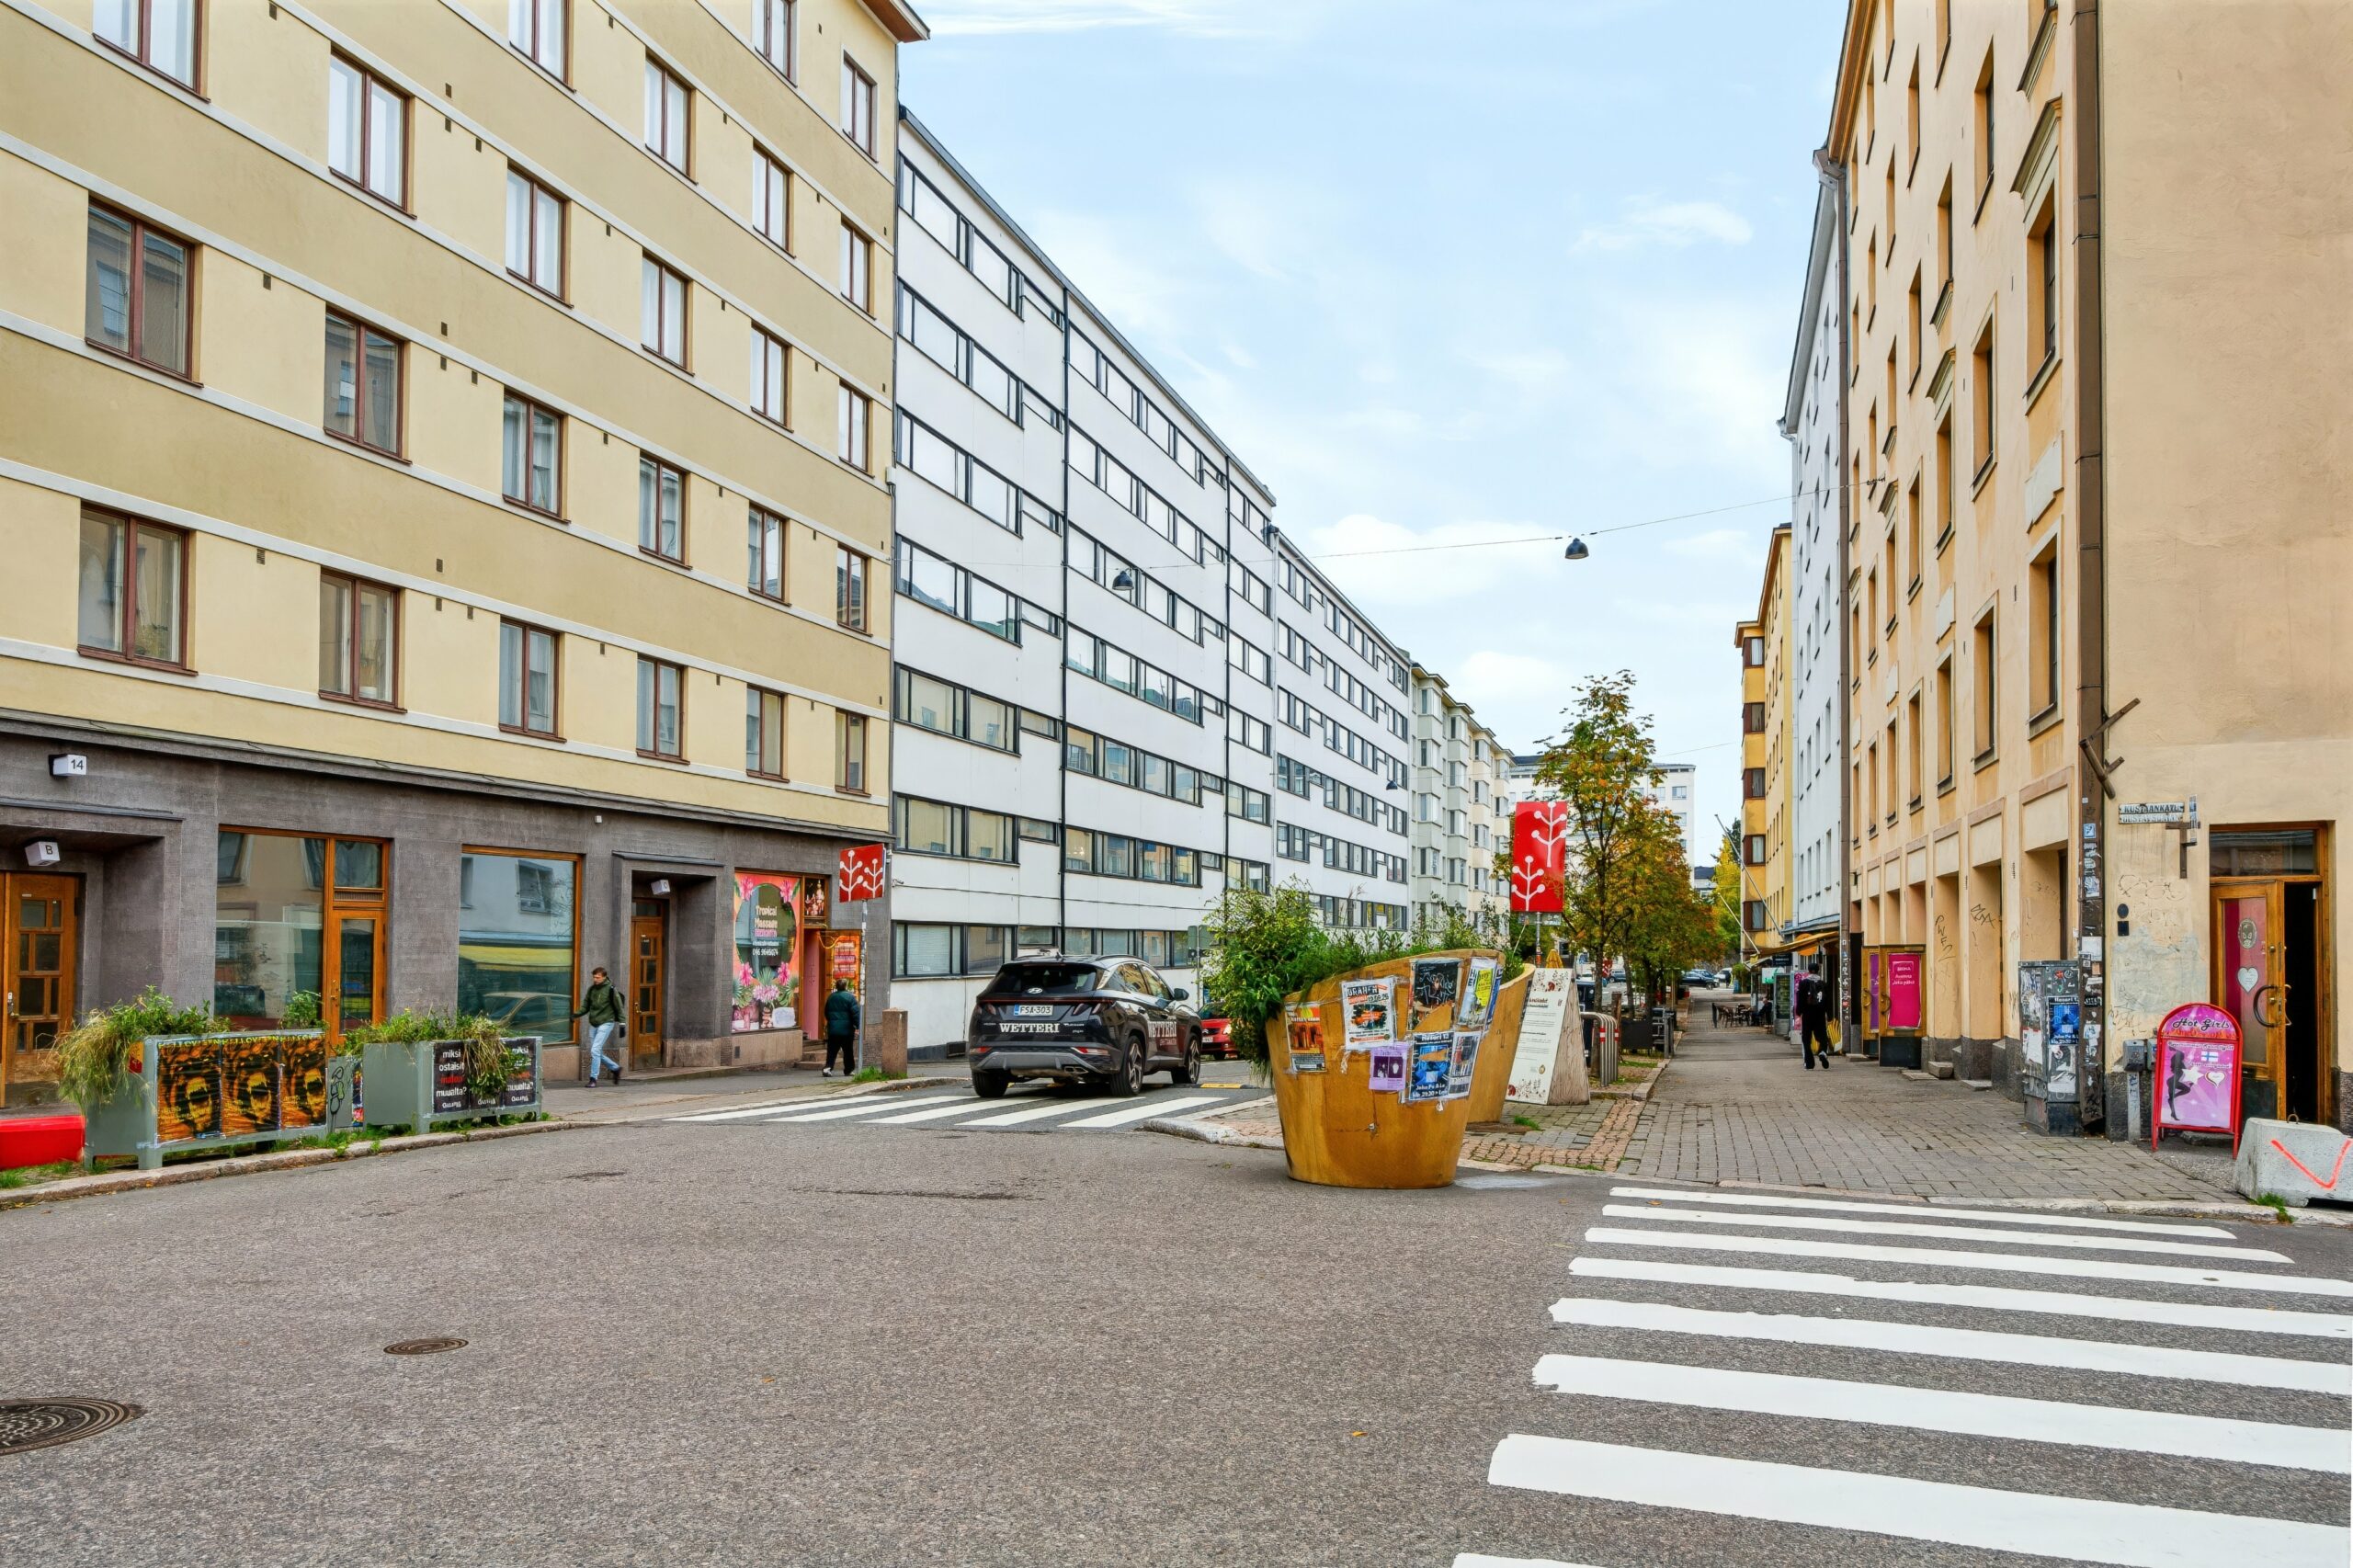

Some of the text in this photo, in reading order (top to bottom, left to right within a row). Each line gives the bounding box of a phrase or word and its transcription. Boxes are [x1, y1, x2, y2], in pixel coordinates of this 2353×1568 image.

[71, 759, 84, 770] 14
[45, 845, 53, 855] B
[756, 905, 778, 916] Tropical
[754, 917, 779, 929] Massage
[1019, 1006, 1051, 1014] FSA-303
[999, 1022, 1060, 1033] WETTERI
[1148, 1020, 1176, 1038] WETTERI
[2172, 1017, 2230, 1031] Hot Girls
[442, 1049, 461, 1059] miksi
[511, 1046, 529, 1055] miksi
[438, 1062, 464, 1072] ostaisit
[436, 1085, 468, 1097] muualta?
[506, 1081, 533, 1092] muualta?
